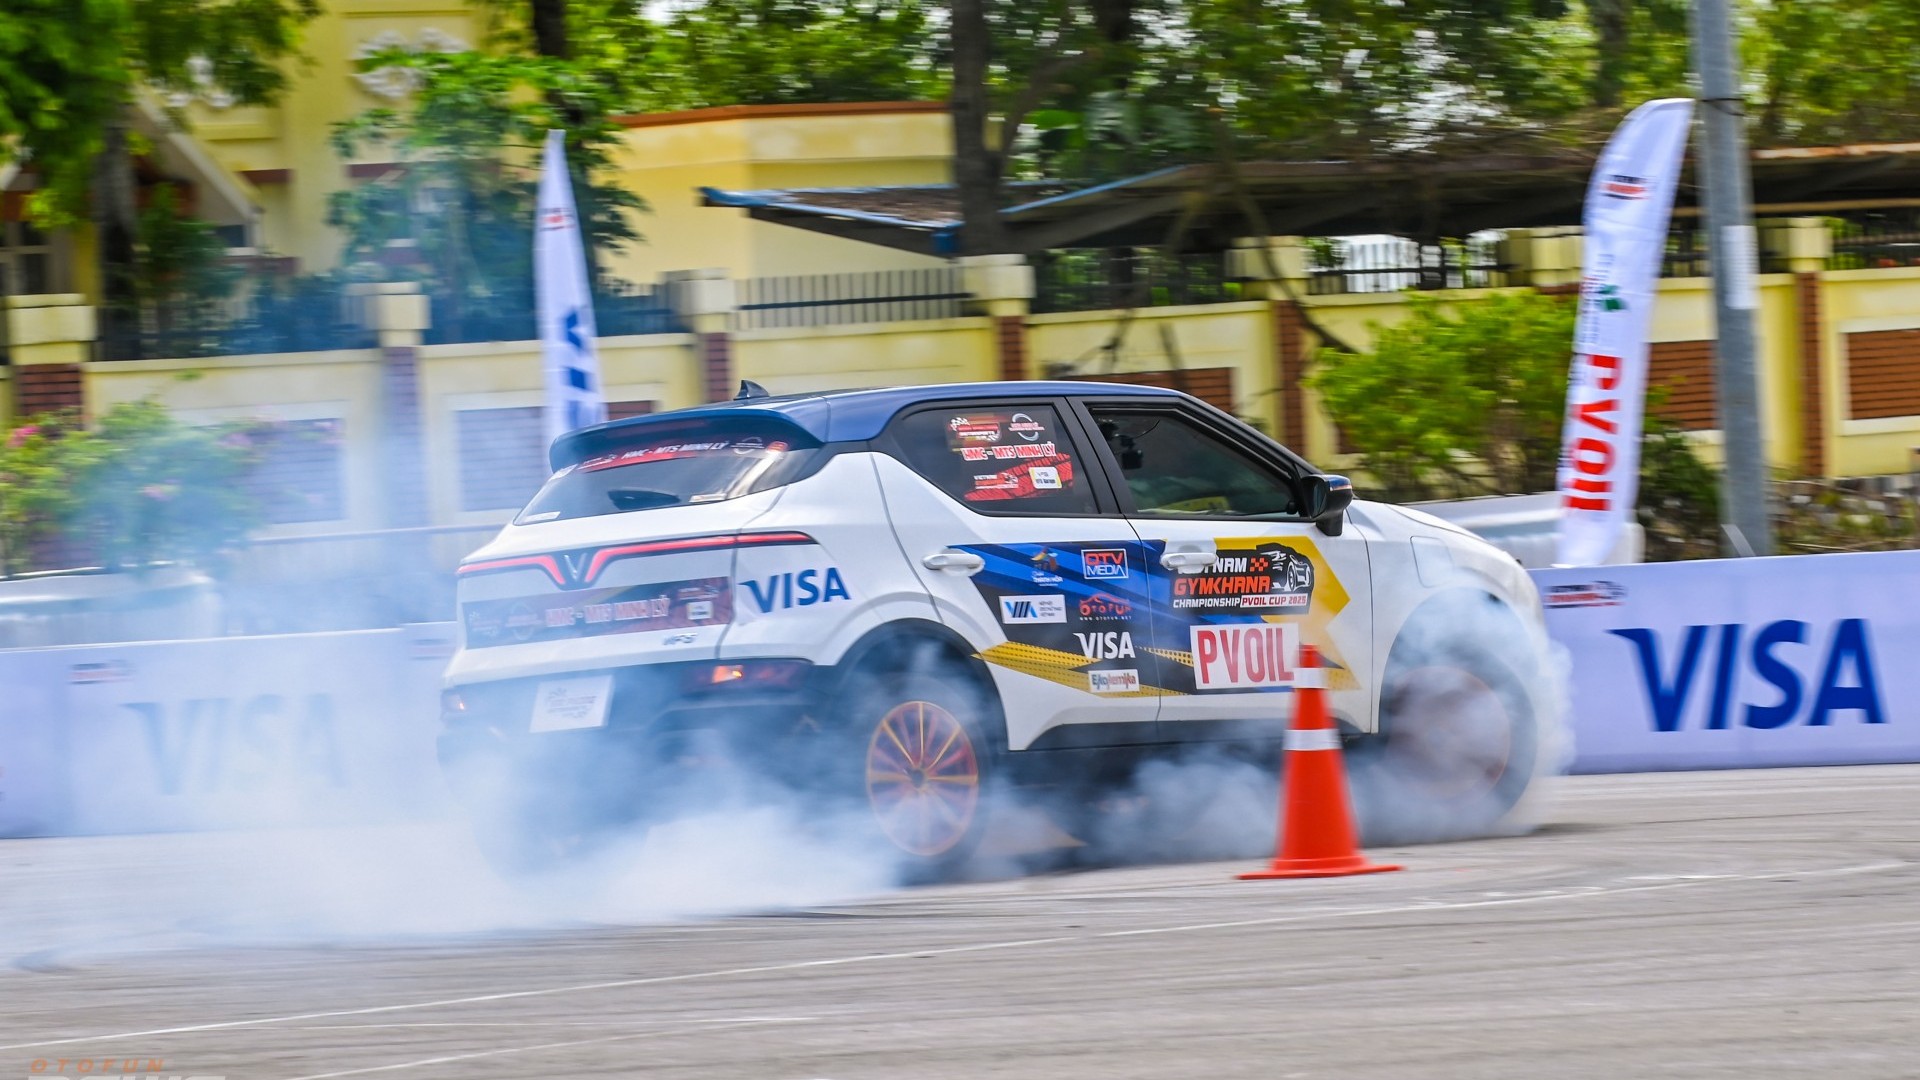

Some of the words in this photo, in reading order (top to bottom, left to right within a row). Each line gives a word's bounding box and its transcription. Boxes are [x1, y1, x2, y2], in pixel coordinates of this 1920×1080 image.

[1564, 354, 1623, 512] PVOIL
[992, 445, 1016, 459] MTS
[1014, 444, 1044, 458] MINH
[1087, 565, 1126, 576] MEDIA
[739, 567, 851, 614] VISA
[1174, 576, 1271, 596] GYMKHANA
[1173, 597, 1240, 609] CHAMPIONSHIP
[1242, 596, 1267, 606] PVOIL
[1269, 595, 1287, 606] CUP
[1073, 631, 1136, 660] VISA
[1197, 627, 1295, 685] PVOIL
[1609, 618, 1886, 732] VISA
